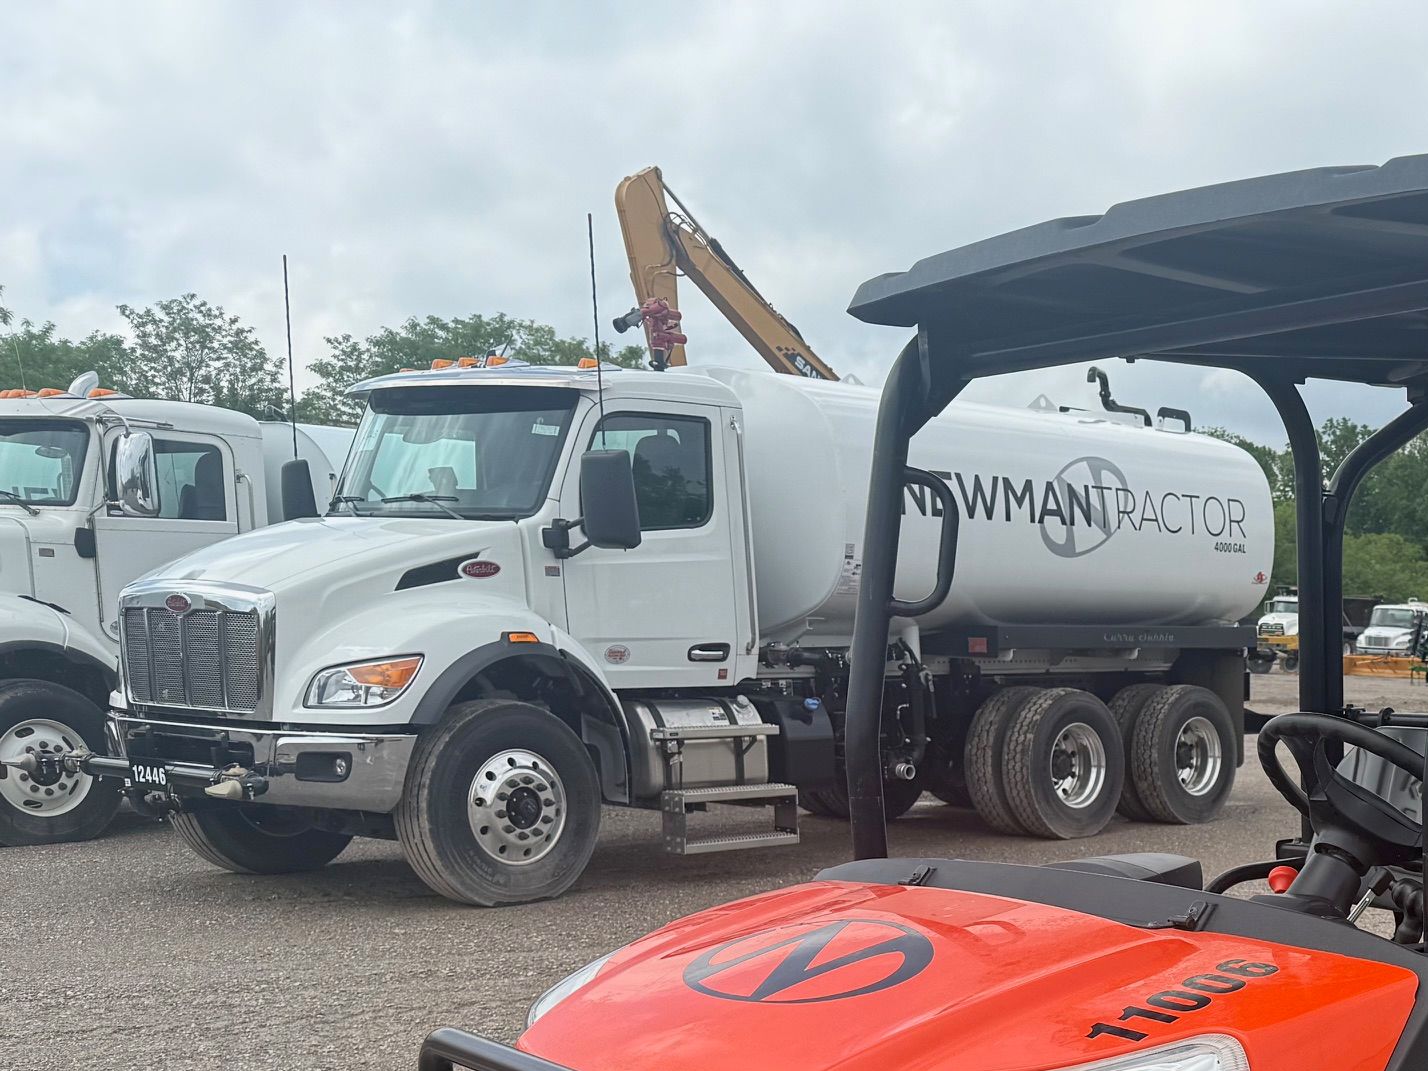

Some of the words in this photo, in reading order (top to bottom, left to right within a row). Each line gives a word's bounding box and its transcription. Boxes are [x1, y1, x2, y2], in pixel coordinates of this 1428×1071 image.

[1214, 541, 1232, 553] 4000
[1233, 543, 1247, 554] GAL
[132, 764, 167, 785] 12446
[1085, 958, 1280, 1042] 11006
